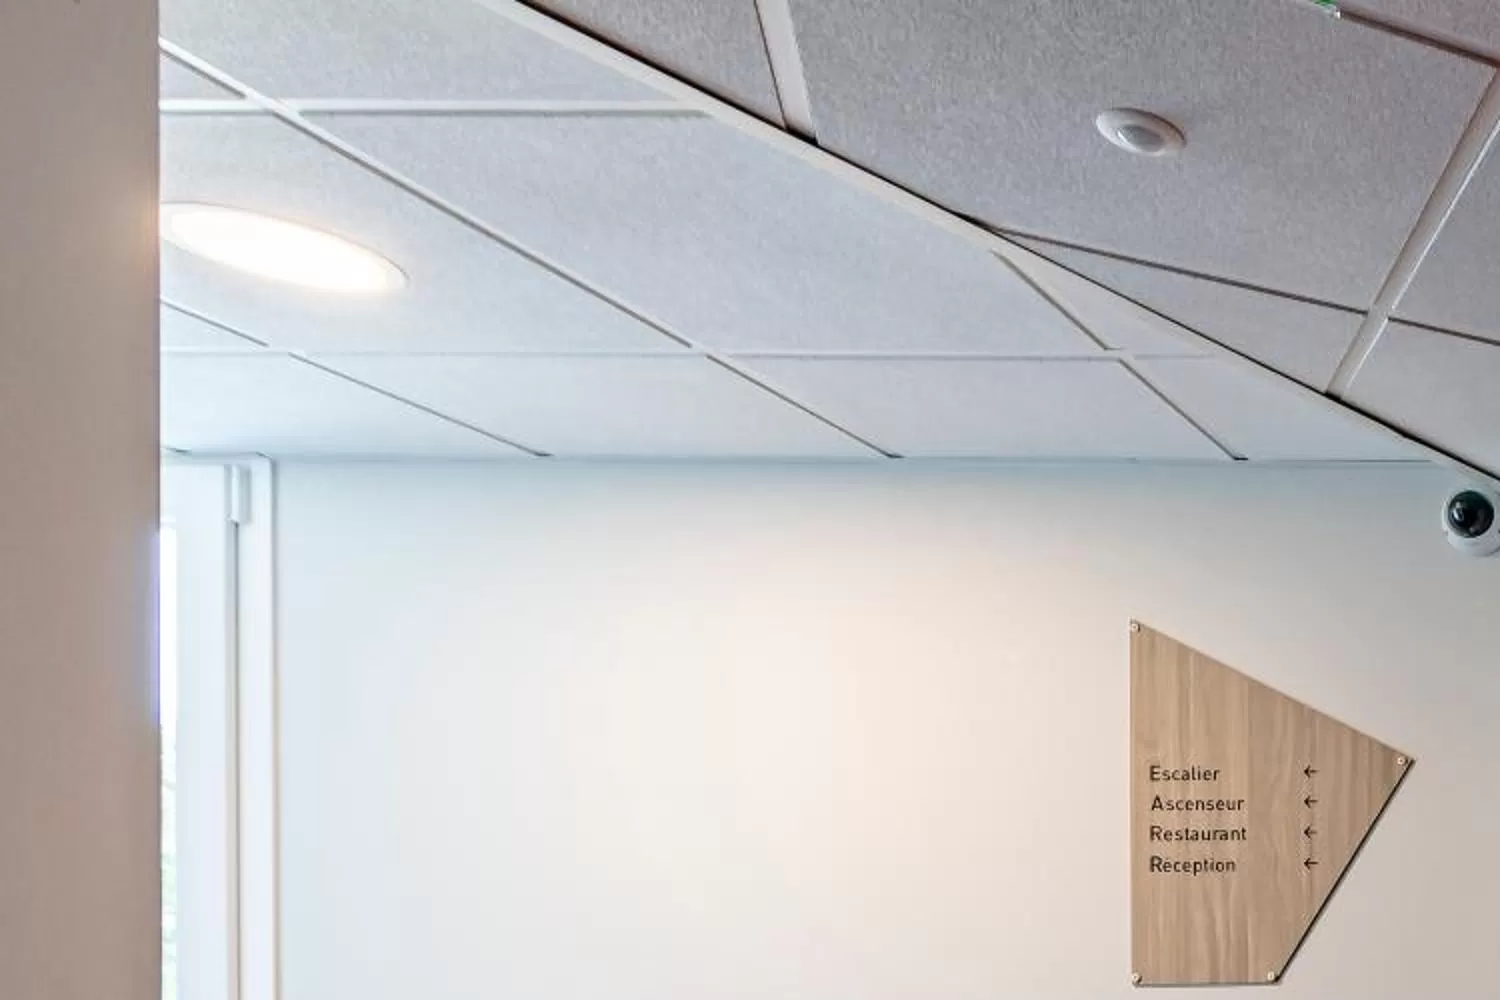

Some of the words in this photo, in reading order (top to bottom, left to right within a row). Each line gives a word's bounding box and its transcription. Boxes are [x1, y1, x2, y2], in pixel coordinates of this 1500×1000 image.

[1149, 765, 1221, 781] Escalier
[1151, 795, 1245, 811] Ascenseur
[1149, 825, 1248, 841] Restaurant
